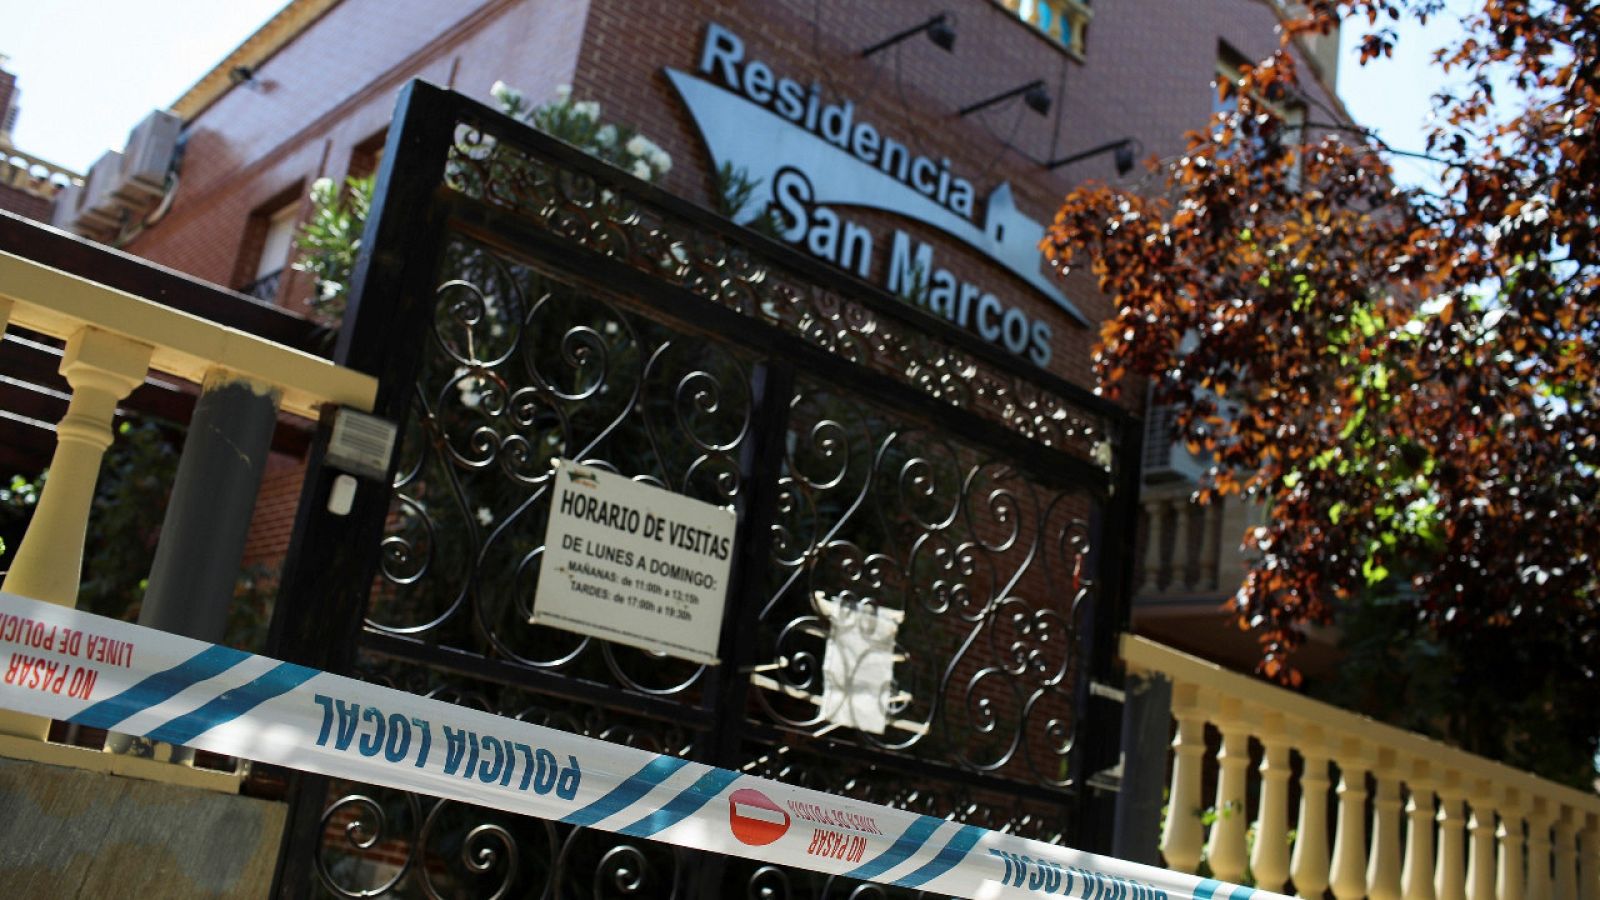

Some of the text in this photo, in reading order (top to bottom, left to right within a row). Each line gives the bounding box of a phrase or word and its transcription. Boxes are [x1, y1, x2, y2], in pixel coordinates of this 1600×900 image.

[700, 22, 975, 220] Residencia
[773, 170, 1053, 368] San Marcos
[561, 489, 730, 561] HORARIO DE VISITAS
[562, 534, 718, 591] DE LUNES A DOMINGO:
[621, 576, 632, 587] de
[570, 580, 610, 600] TARDES:
[613, 593, 625, 605] de
[0, 612, 134, 668] LINEA DE POLICI
[4, 652, 99, 700] NO PASAR
[314, 694, 582, 800] POLICIA LOCAL
[807, 828, 867, 863] NO PASAR
